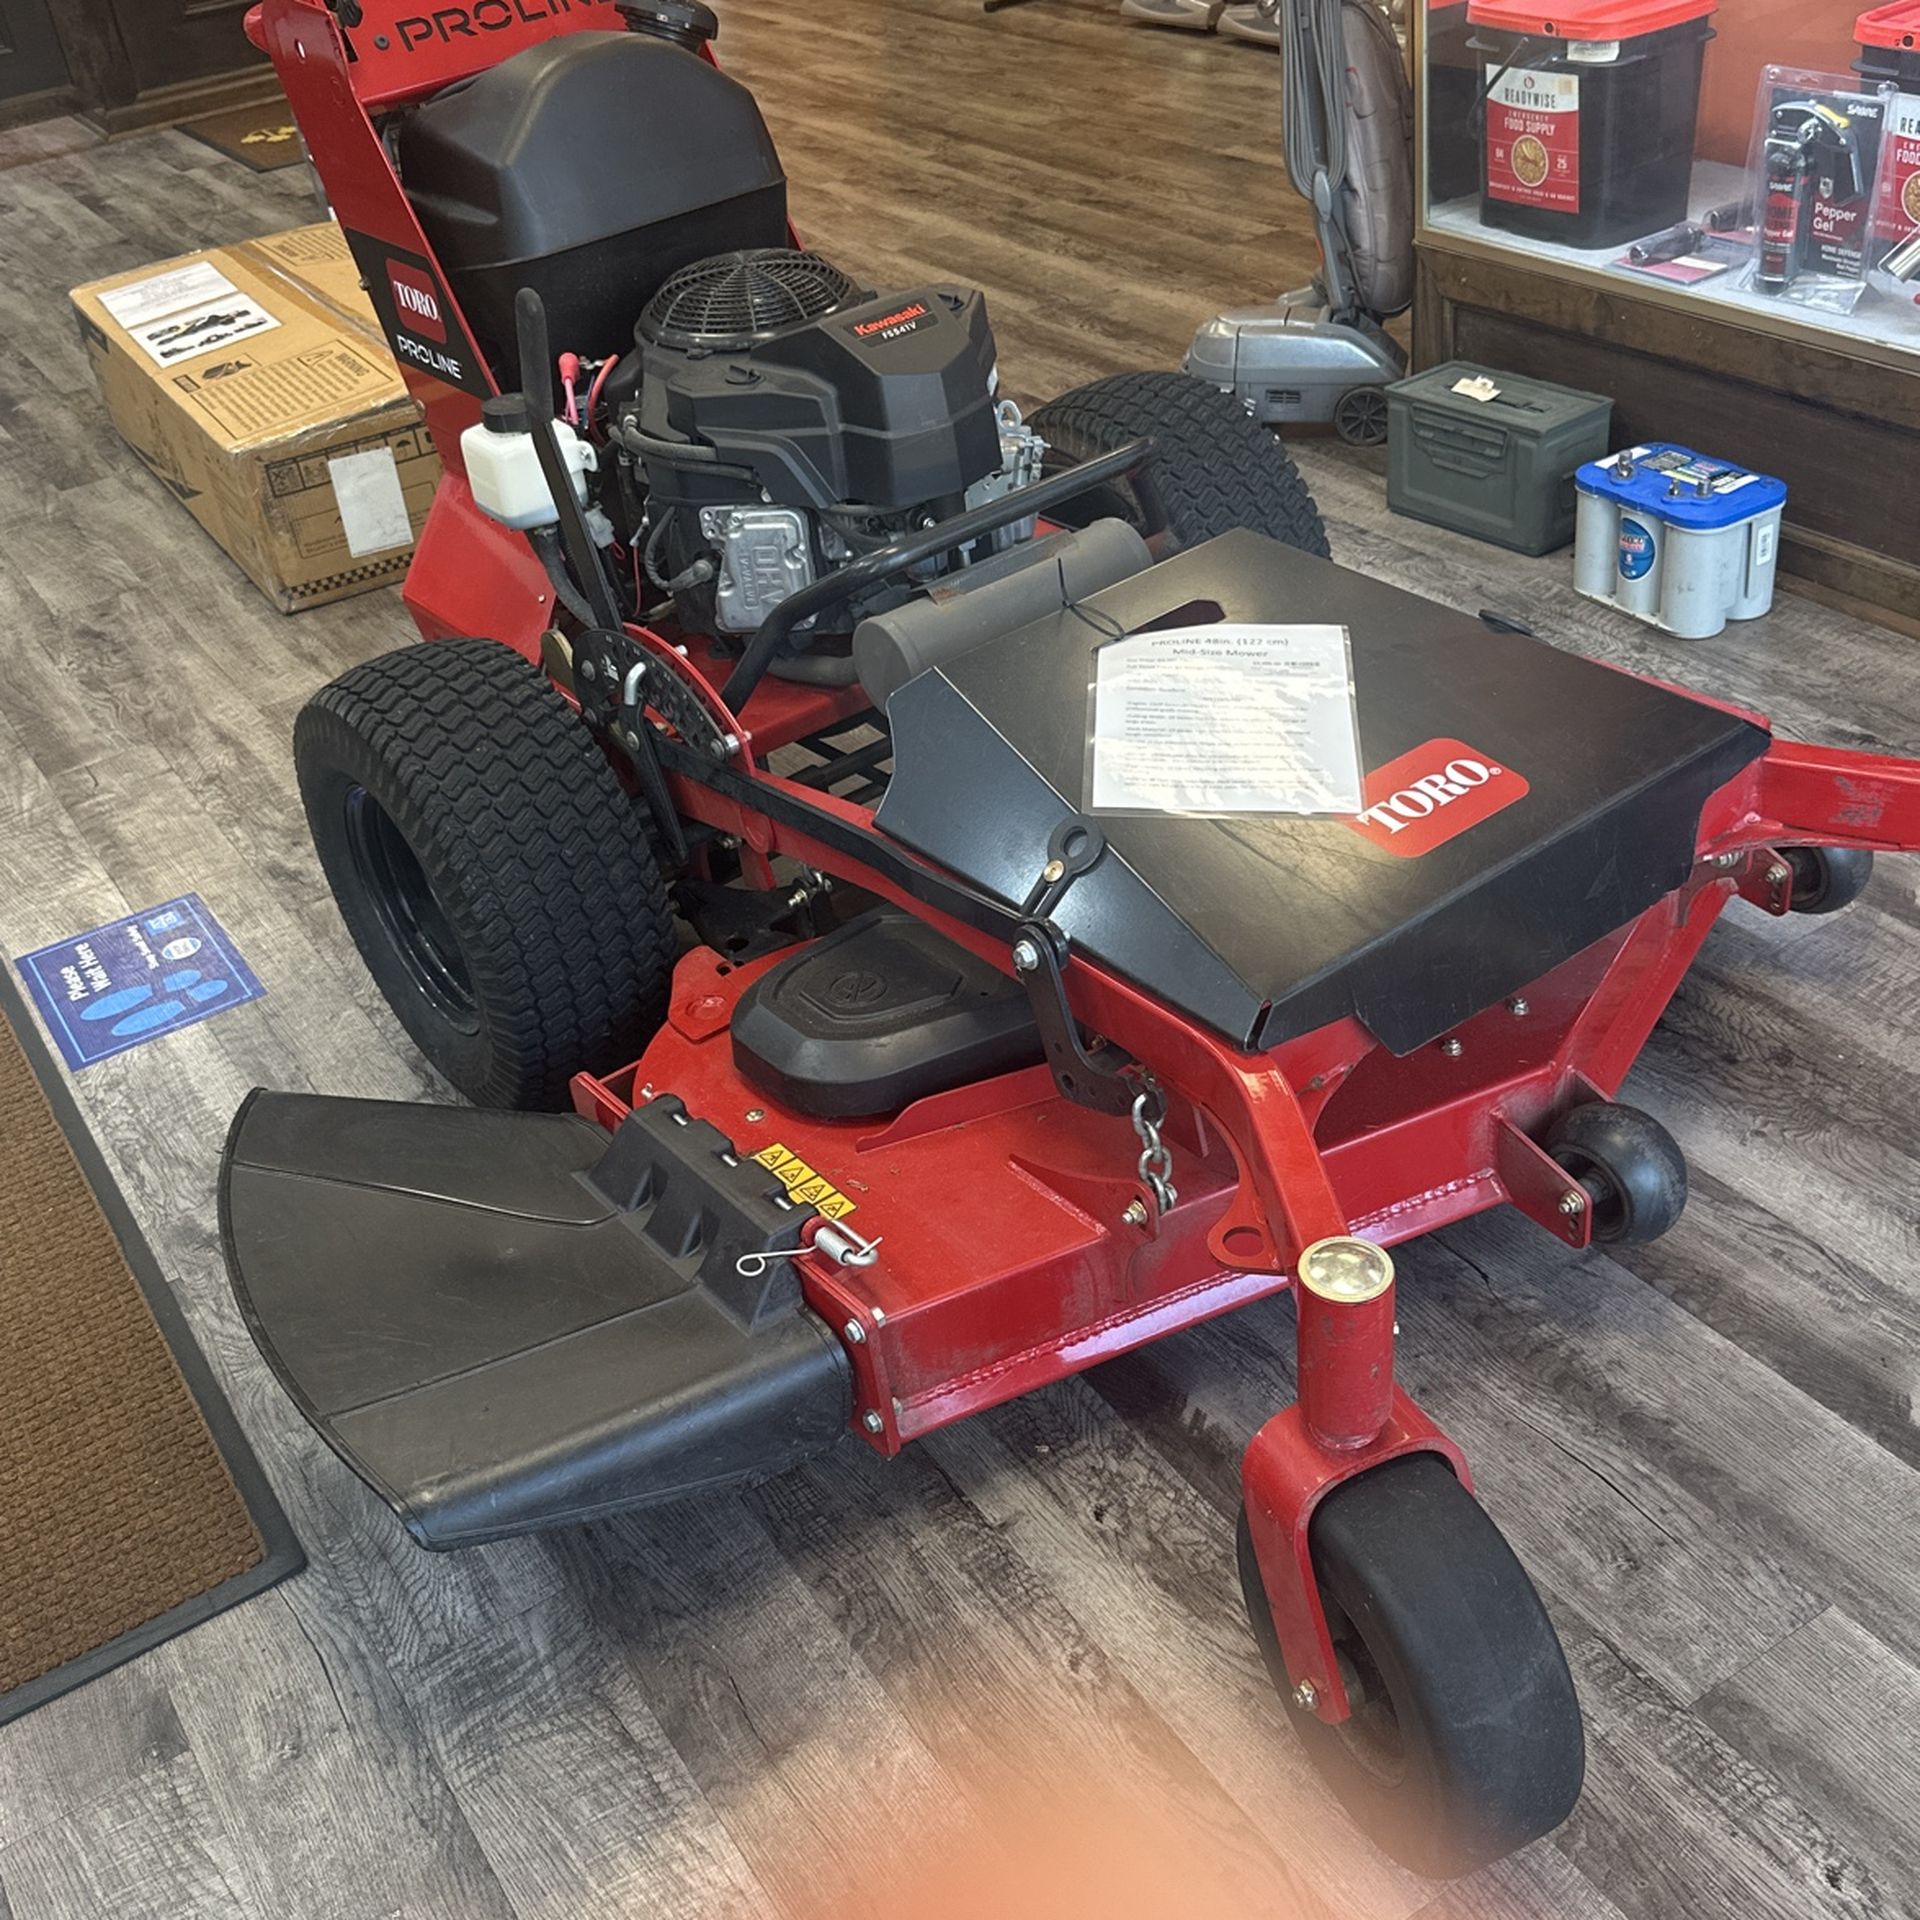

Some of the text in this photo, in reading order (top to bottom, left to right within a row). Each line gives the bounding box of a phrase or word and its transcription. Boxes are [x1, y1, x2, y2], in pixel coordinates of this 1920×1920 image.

[1504, 87, 1556, 109] READYWISE
[1504, 117, 1556, 136] FOOD SUPPLY
[1813, 217, 1834, 233] Gel
[1814, 202, 1857, 221] Pepper
[393, 280, 438, 321] TORO
[853, 303, 926, 337] Kawasaki
[396, 333, 462, 380] PROLINE
[1172, 648, 1223, 656] Mid-Size
[1355, 759, 1490, 835] TORO
[60, 965, 90, 1002] Please
[74, 942, 113, 993] Wait Here
